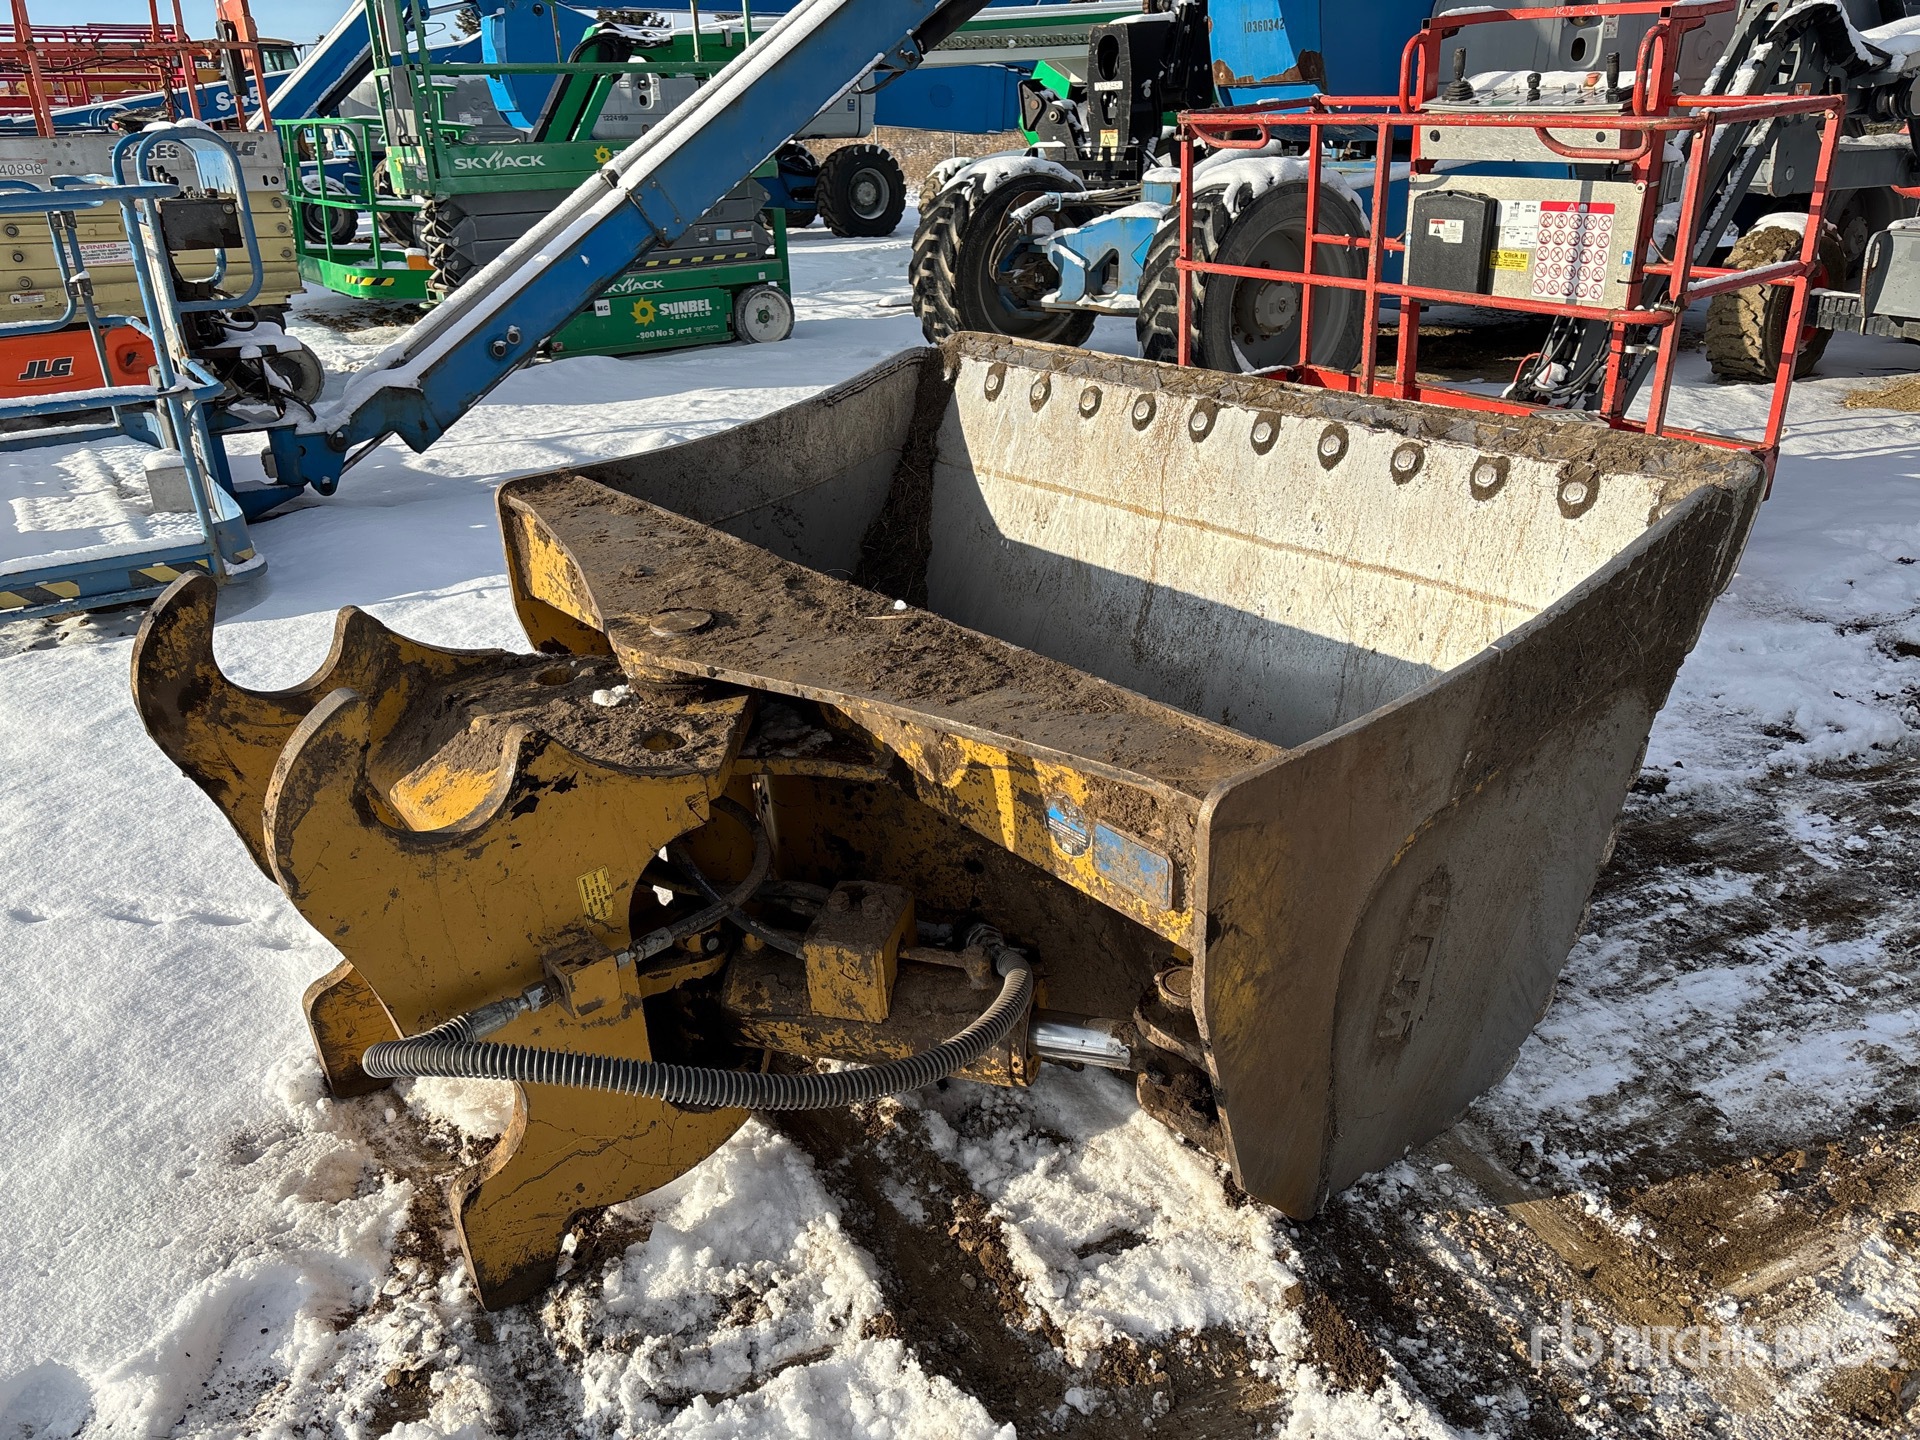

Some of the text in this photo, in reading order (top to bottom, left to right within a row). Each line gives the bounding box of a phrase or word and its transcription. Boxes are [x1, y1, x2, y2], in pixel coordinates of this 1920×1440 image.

[227, 141, 257, 156] LG
[454, 150, 546, 170] SKYJACK
[670, 311, 711, 320] ENTALS
[18, 356, 74, 382] JLG
